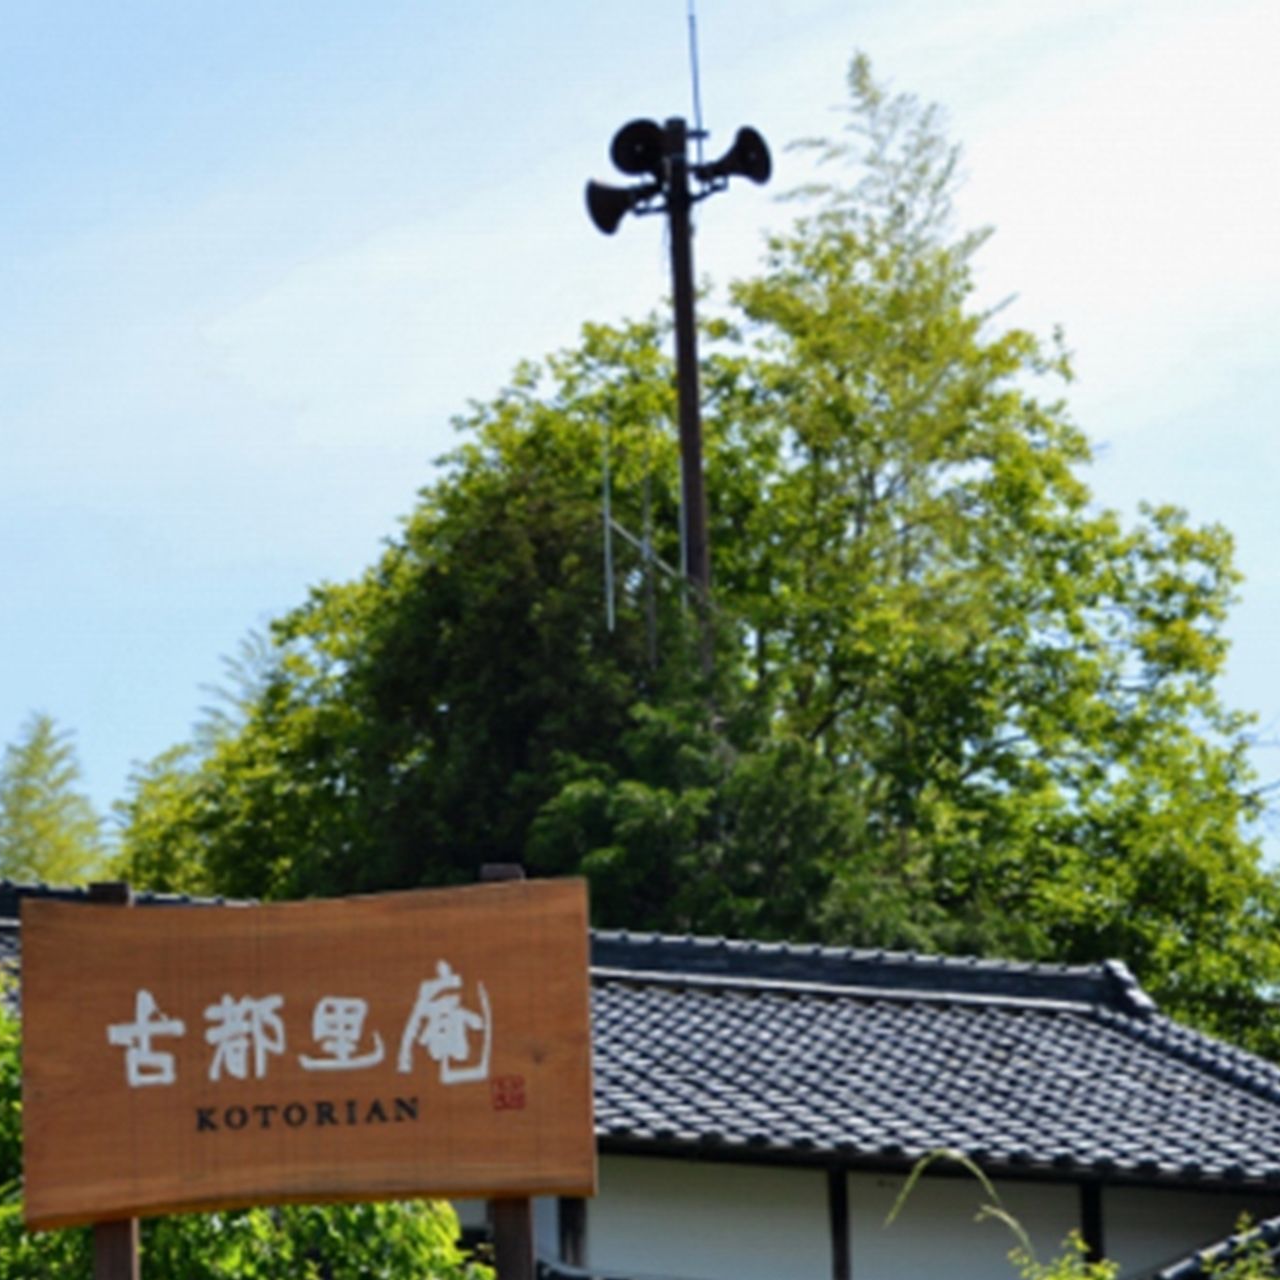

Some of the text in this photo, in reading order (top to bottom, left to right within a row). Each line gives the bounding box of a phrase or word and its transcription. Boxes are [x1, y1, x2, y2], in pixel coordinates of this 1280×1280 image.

[107, 960, 491, 1086] 古都里庵
[196, 1097, 419, 1132] KOTORIAN
